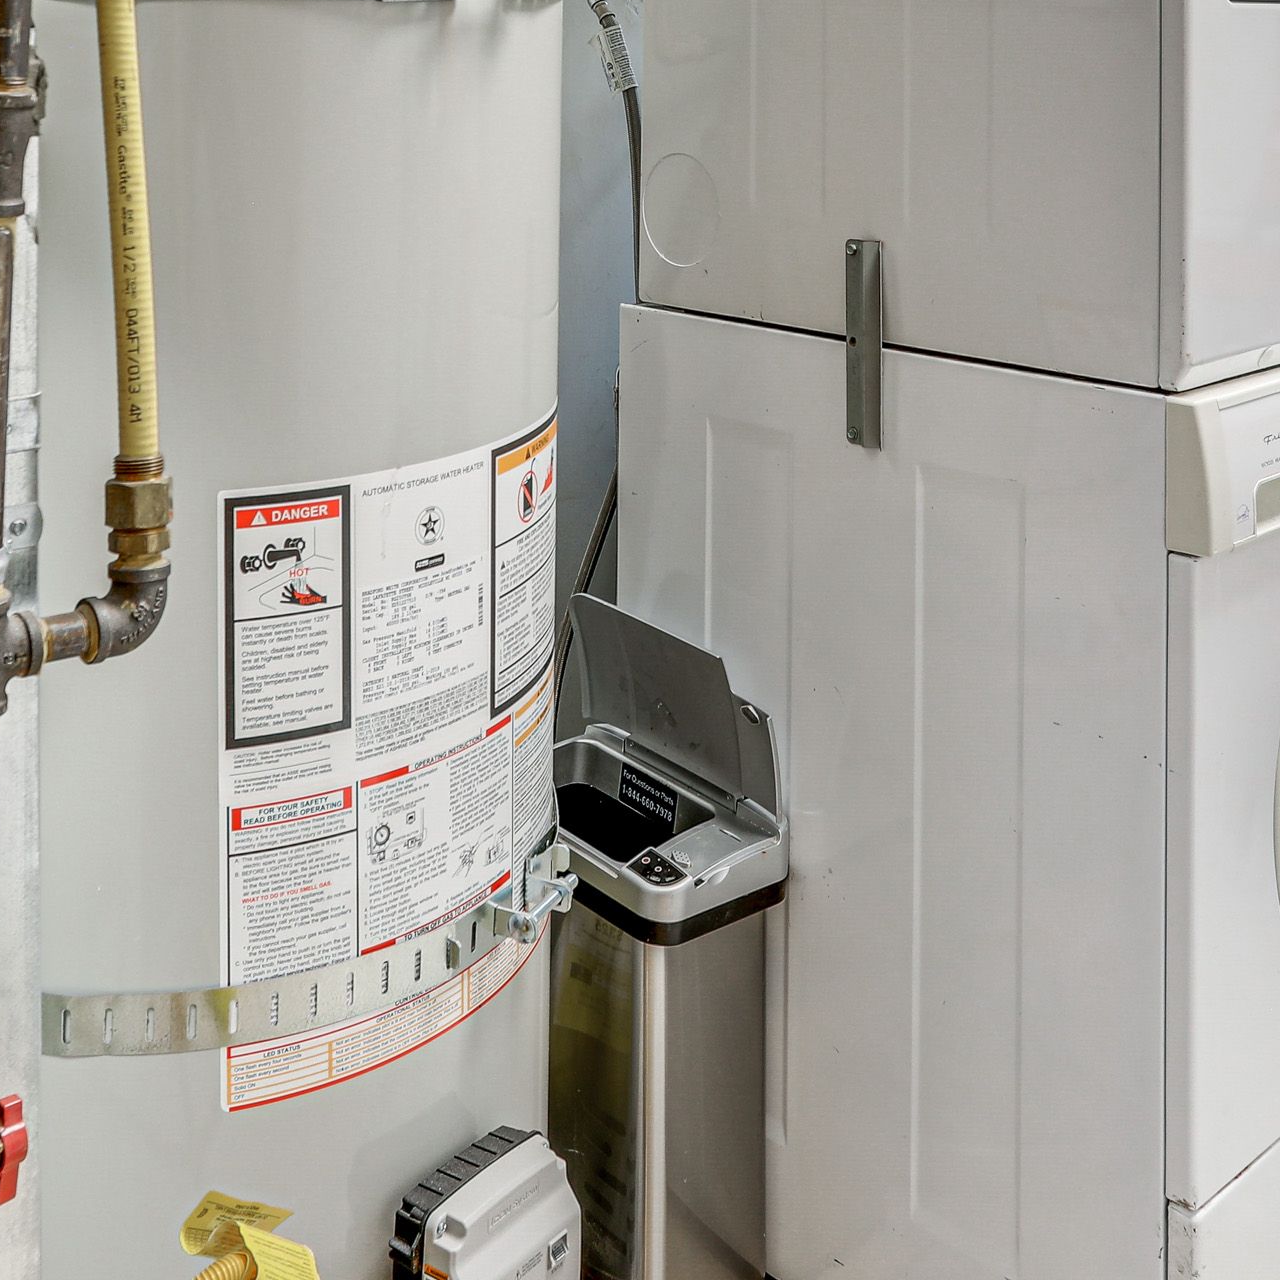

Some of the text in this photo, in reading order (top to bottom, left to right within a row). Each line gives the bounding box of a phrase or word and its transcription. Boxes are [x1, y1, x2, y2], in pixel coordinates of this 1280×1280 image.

[121, 245, 138, 274] 1/2
[362, 461, 484, 497] AUTOMATIC STORAGE WATER HEATER
[271, 504, 328, 522] DANGER
[289, 567, 310, 578] HOT
[241, 625, 261, 633] Water
[261, 621, 297, 631] temperature
[261, 654, 283, 663] highest
[303, 648, 320, 657] being
[271, 645, 296, 653] disabled
[309, 640, 328, 648] elderly
[255, 671, 287, 681] instruction
[288, 668, 310, 676] manual
[311, 664, 328, 672] before
[263, 676, 300, 687] temperature
[414, 733, 483, 770] OPERATING INSTRUCTIONS
[623, 769, 631, 779] For
[243, 800, 342, 826] READ BEFORE OPERATING
[258, 796, 329, 816] FOR YOUR SAFETY
[241, 896, 260, 904] WHAT
[286, 889, 299, 897] YOU
[299, 885, 318, 894] SMELL
[414, 925, 429, 938] TURN
[430, 919, 441, 931] OFF
[442, 913, 454, 925] GAS
[454, 907, 462, 917] TO
[461, 891, 489, 913] APPLIANCE
[375, 994, 431, 1023] OPERATIONAL STATUS
[277, 1044, 301, 1055] STATUS
